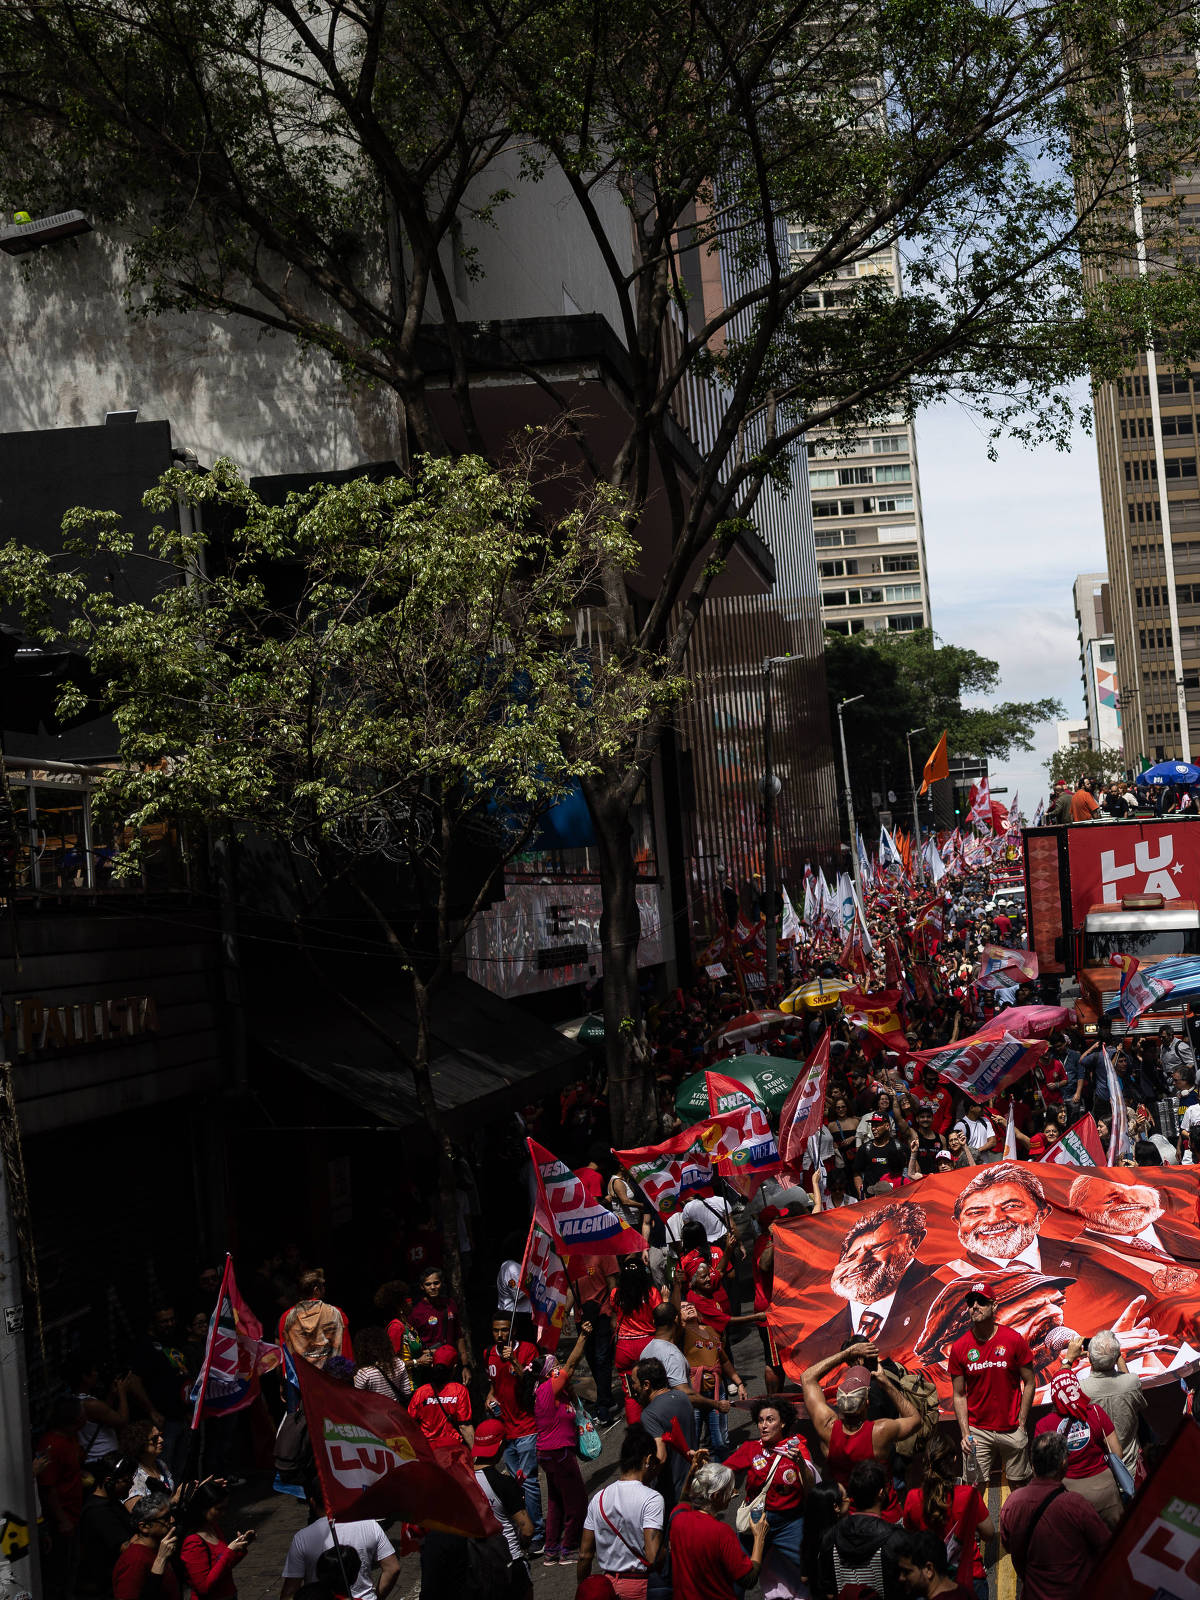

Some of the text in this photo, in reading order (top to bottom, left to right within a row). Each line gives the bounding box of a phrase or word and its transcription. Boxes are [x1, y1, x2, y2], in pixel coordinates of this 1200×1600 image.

[813, 995, 832, 1005] SKOL
[763, 1076, 785, 1091] XEQUE
[769, 1083, 789, 1096] MATE
[692, 1092, 709, 1100] XEQU
[1057, 1385, 1081, 1405] 13
